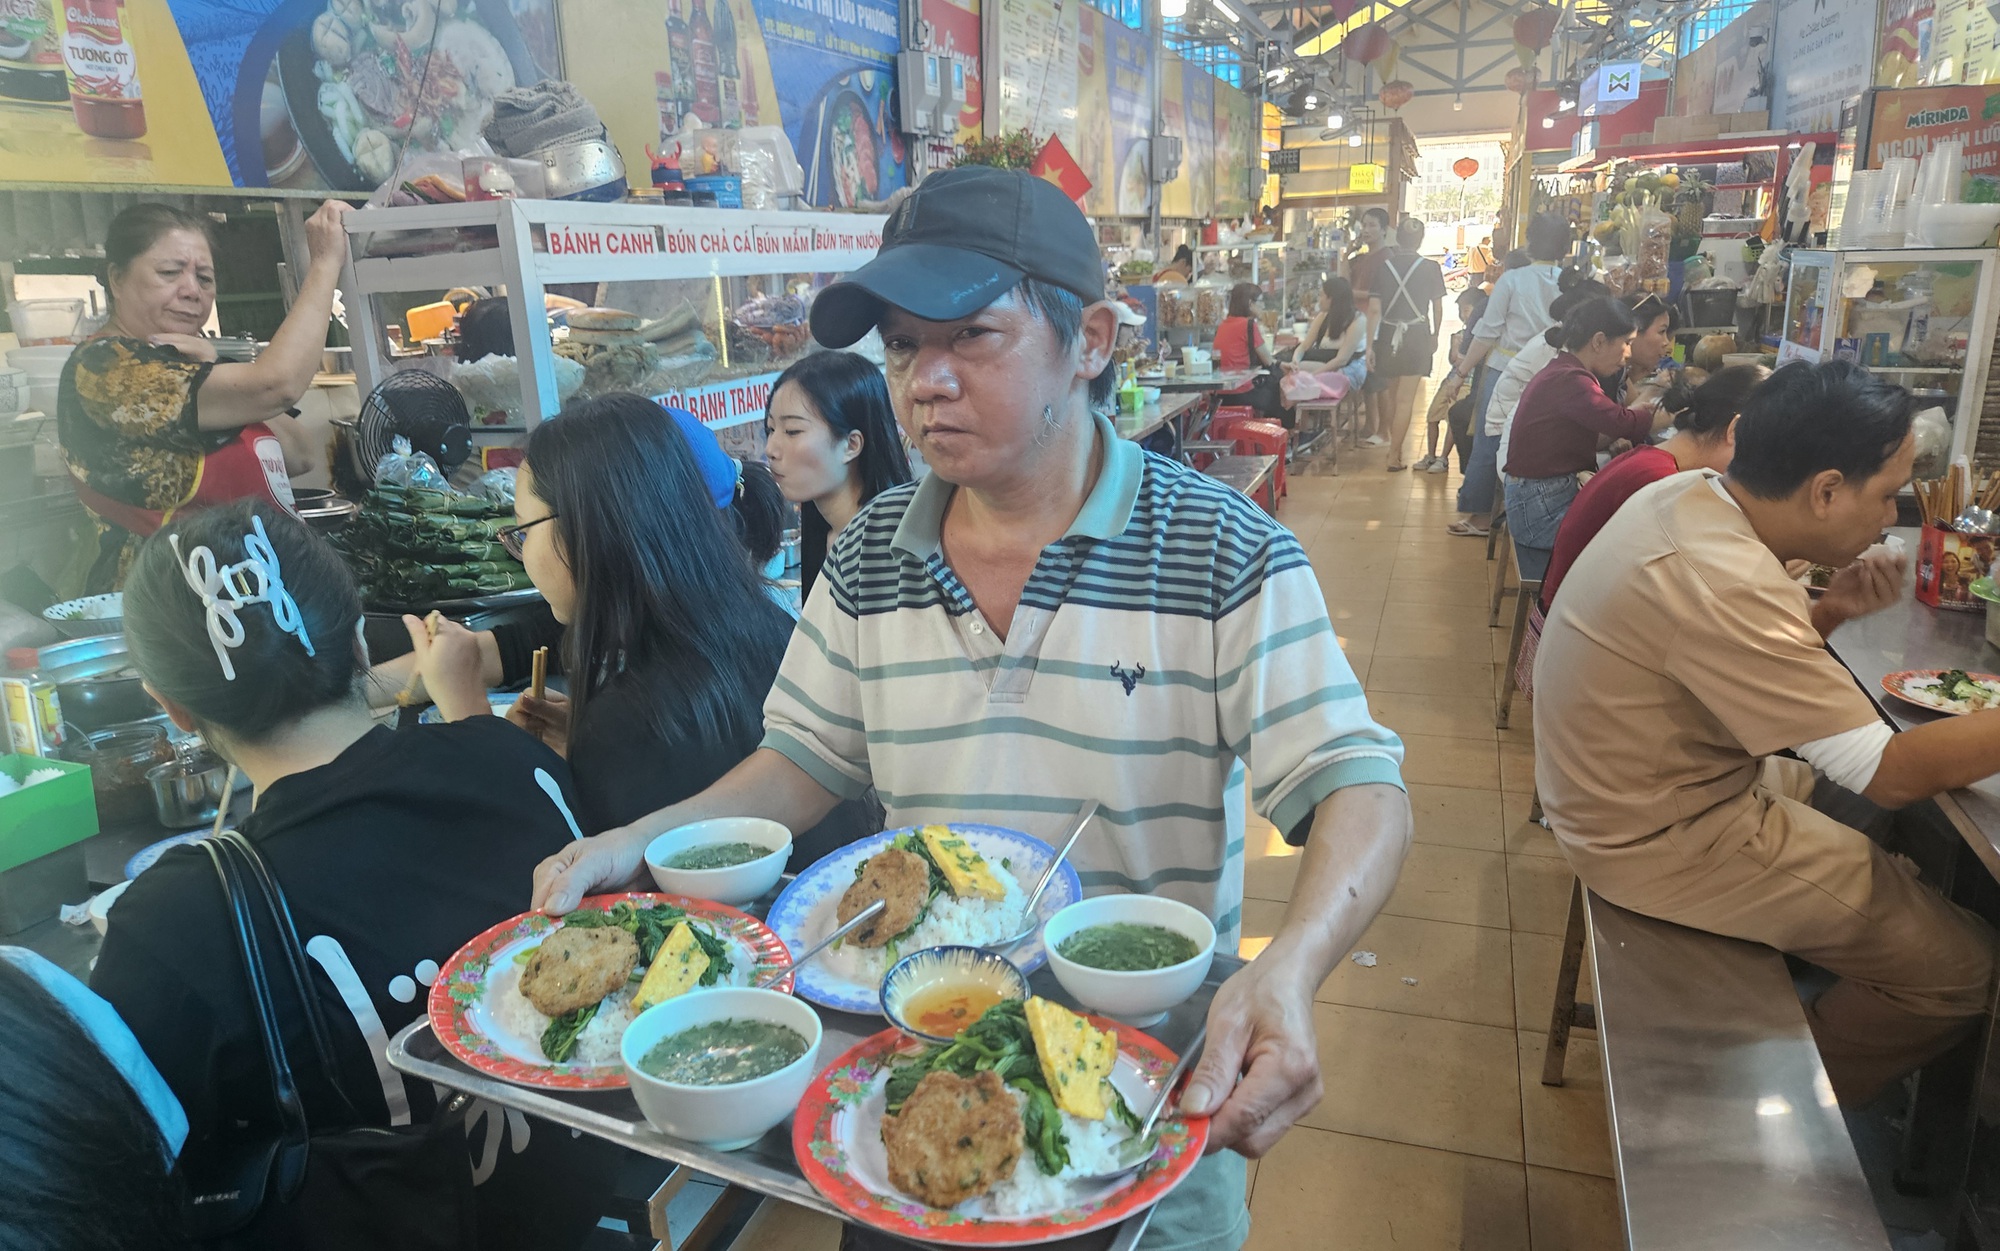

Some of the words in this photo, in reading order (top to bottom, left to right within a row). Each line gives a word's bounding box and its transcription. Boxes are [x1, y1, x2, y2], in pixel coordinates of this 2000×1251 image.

[68, 46, 112, 64] TƯƠNG
[1270, 150, 1299, 165] COFFEE
[550, 226, 601, 255] BÁNH
[606, 232, 654, 254] CANH
[668, 228, 697, 254] BÚN
[700, 228, 730, 253] CHẢ
[733, 230, 751, 253] CÁ
[756, 232, 780, 254] BÚN
[782, 227, 809, 253] MẮM
[816, 229, 837, 250] BÚN
[838, 234, 854, 255] THỊT
[856, 230, 883, 250] NƯỚN
[688, 388, 727, 423] BÁNH
[729, 379, 771, 416] TRÁNG
